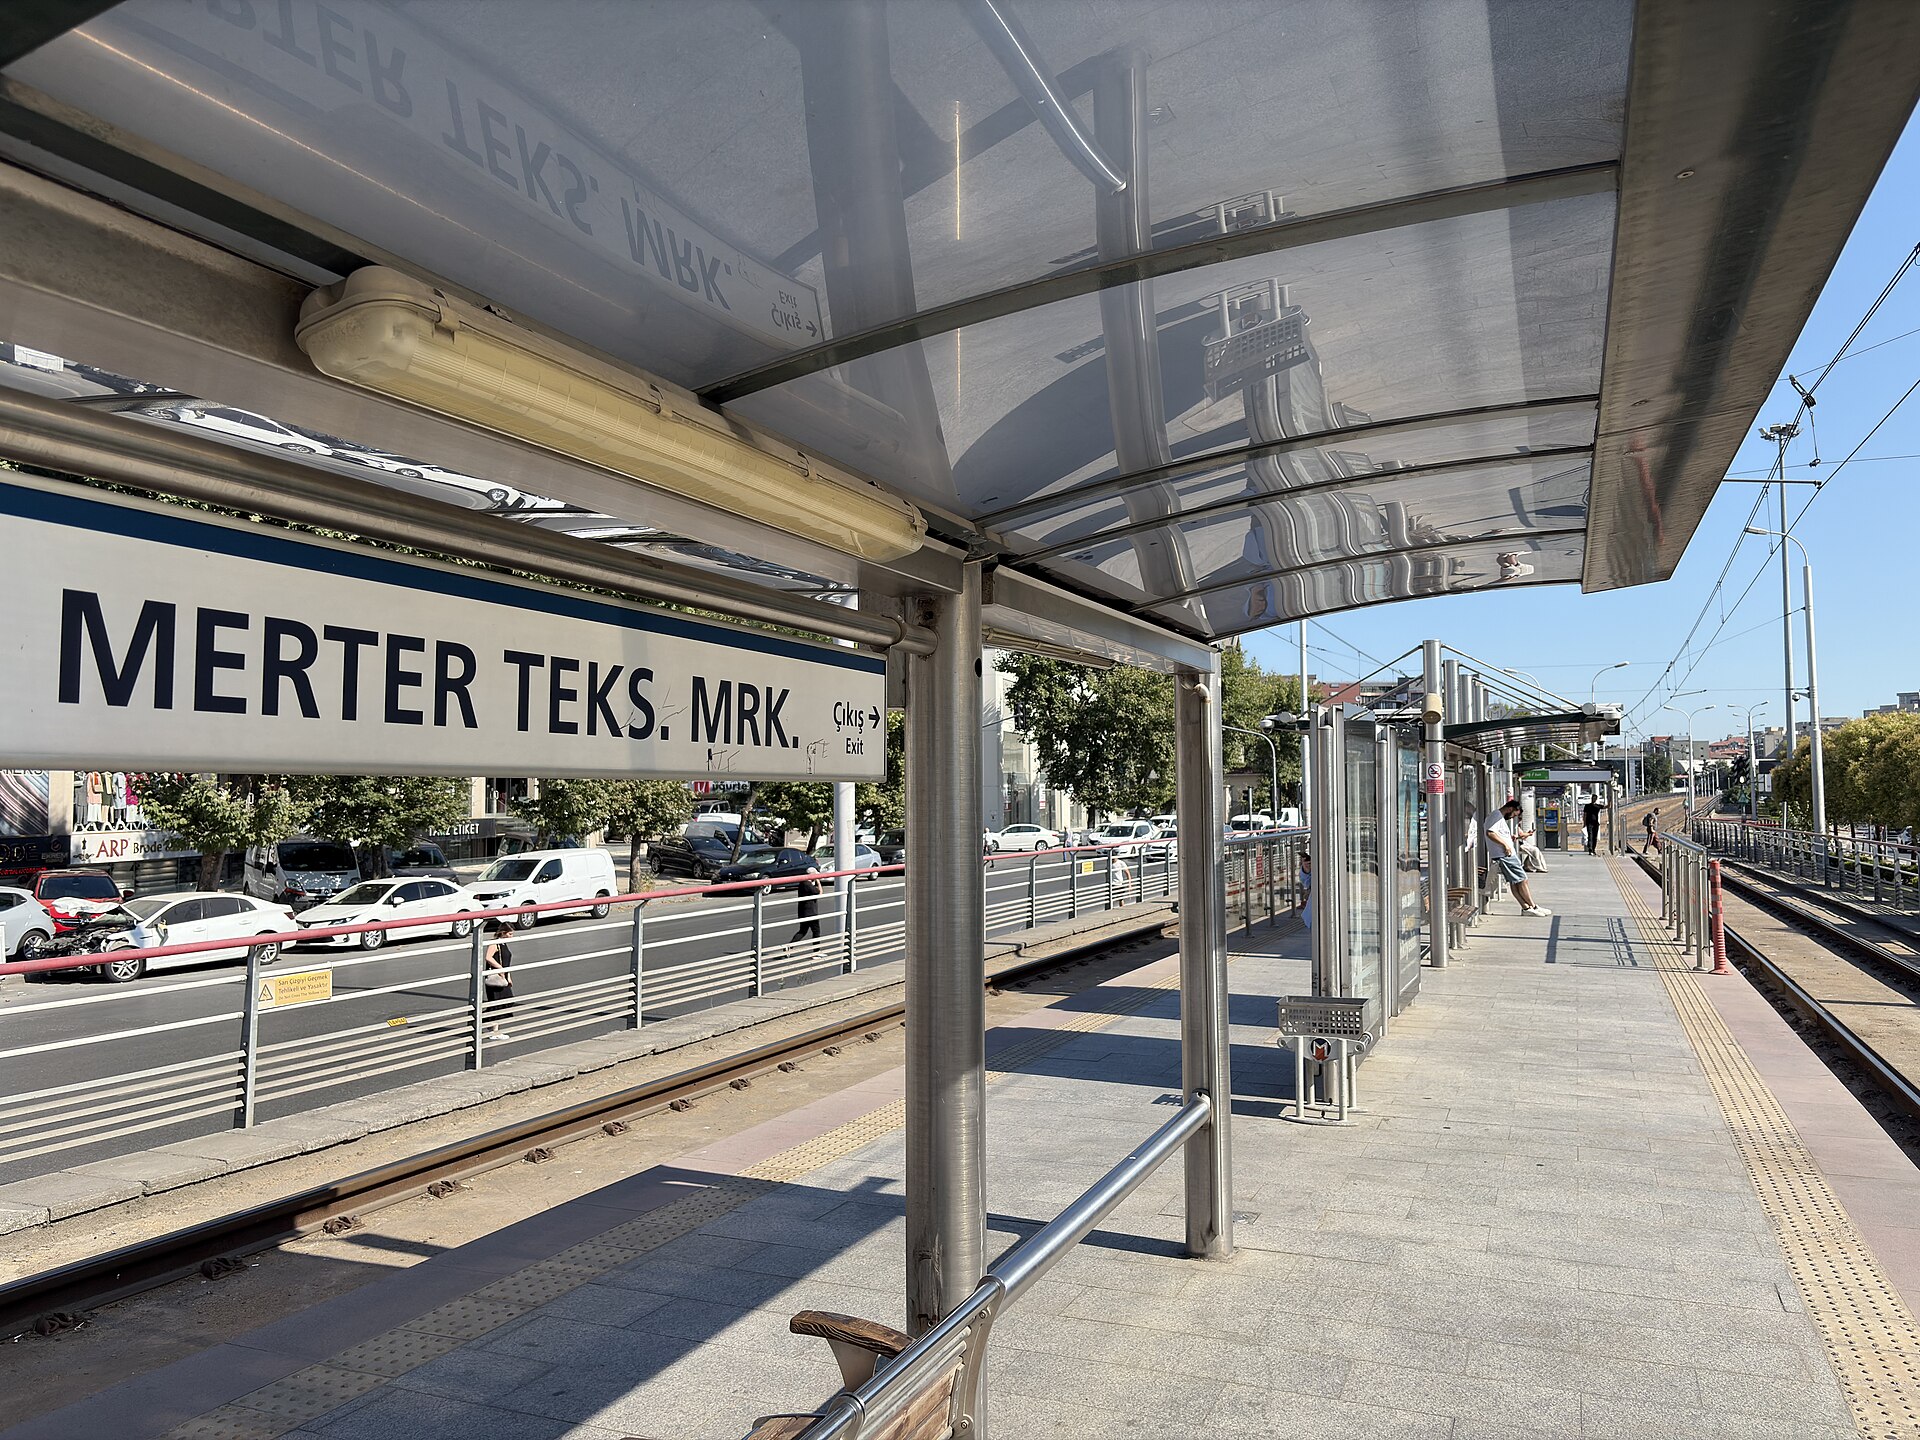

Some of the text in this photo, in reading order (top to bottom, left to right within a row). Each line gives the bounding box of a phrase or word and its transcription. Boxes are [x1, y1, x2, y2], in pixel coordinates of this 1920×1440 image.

[58, 588, 799, 749] MERTER TEKS. MRK.
[833, 701, 864, 735] Çıkış
[845, 737, 864, 755] Exit
[96, 839, 129, 858] ARP
